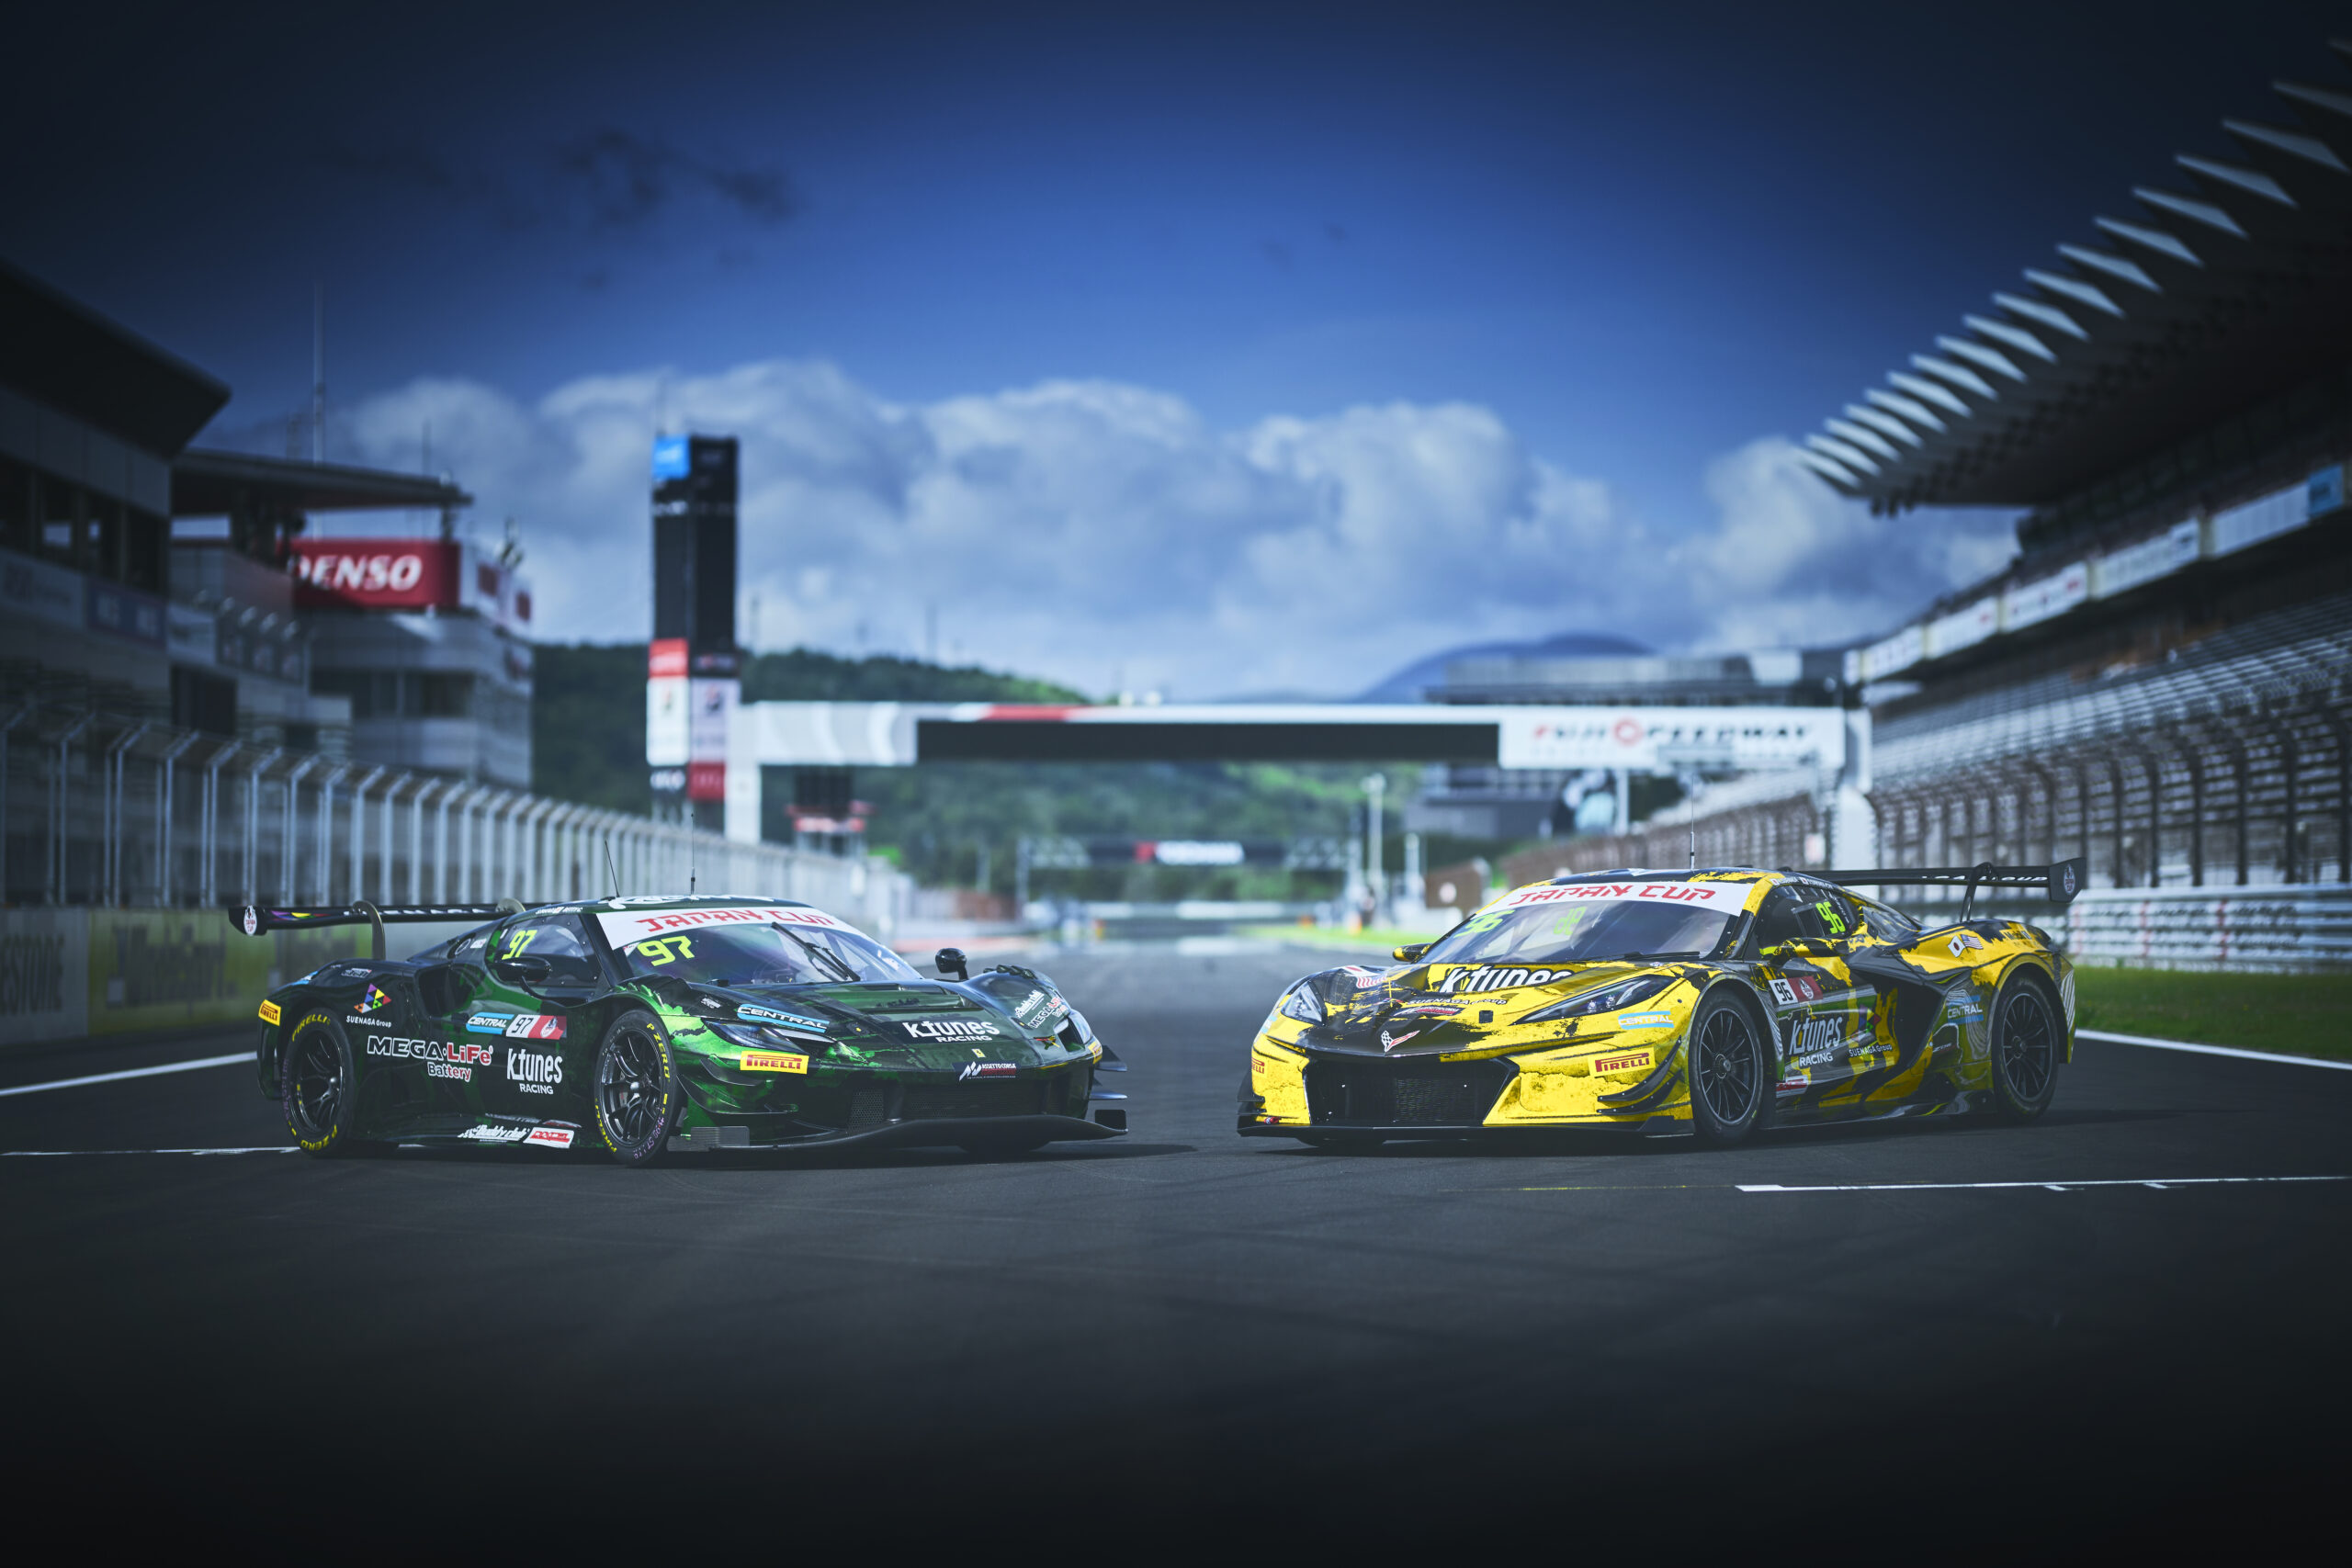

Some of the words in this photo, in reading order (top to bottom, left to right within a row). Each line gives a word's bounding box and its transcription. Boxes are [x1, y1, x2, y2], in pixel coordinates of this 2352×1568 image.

[1509, 885, 1634, 906] JAPAN
[1638, 885, 1716, 901] CUP
[635, 909, 763, 931] JAPAN
[764, 910, 836, 926] CUP
[1815, 901, 1846, 934] 96
[502, 930, 537, 961] 97
[637, 935, 695, 966] 97
[1774, 981, 1794, 1002] 96
[260, 1003, 278, 1021] PIRELLI
[737, 1006, 828, 1030] CENTRAL
[1948, 1003, 1983, 1019] CENTRAL
[346, 1015, 375, 1026] SUENAGA
[376, 1020, 392, 1028] Group
[468, 1016, 507, 1028] CENTRAL
[512, 1016, 533, 1034] 97
[1618, 1015, 1673, 1026] CENTRAL
[1799, 1053, 1834, 1067] RACING
[1849, 1045, 1876, 1057] SUENAGA
[747, 1055, 803, 1070] PIRELLI
[1595, 1053, 1650, 1073] PIRELLI
[427, 1062, 471, 1082] Battery
[519, 1083, 554, 1095] RACING
